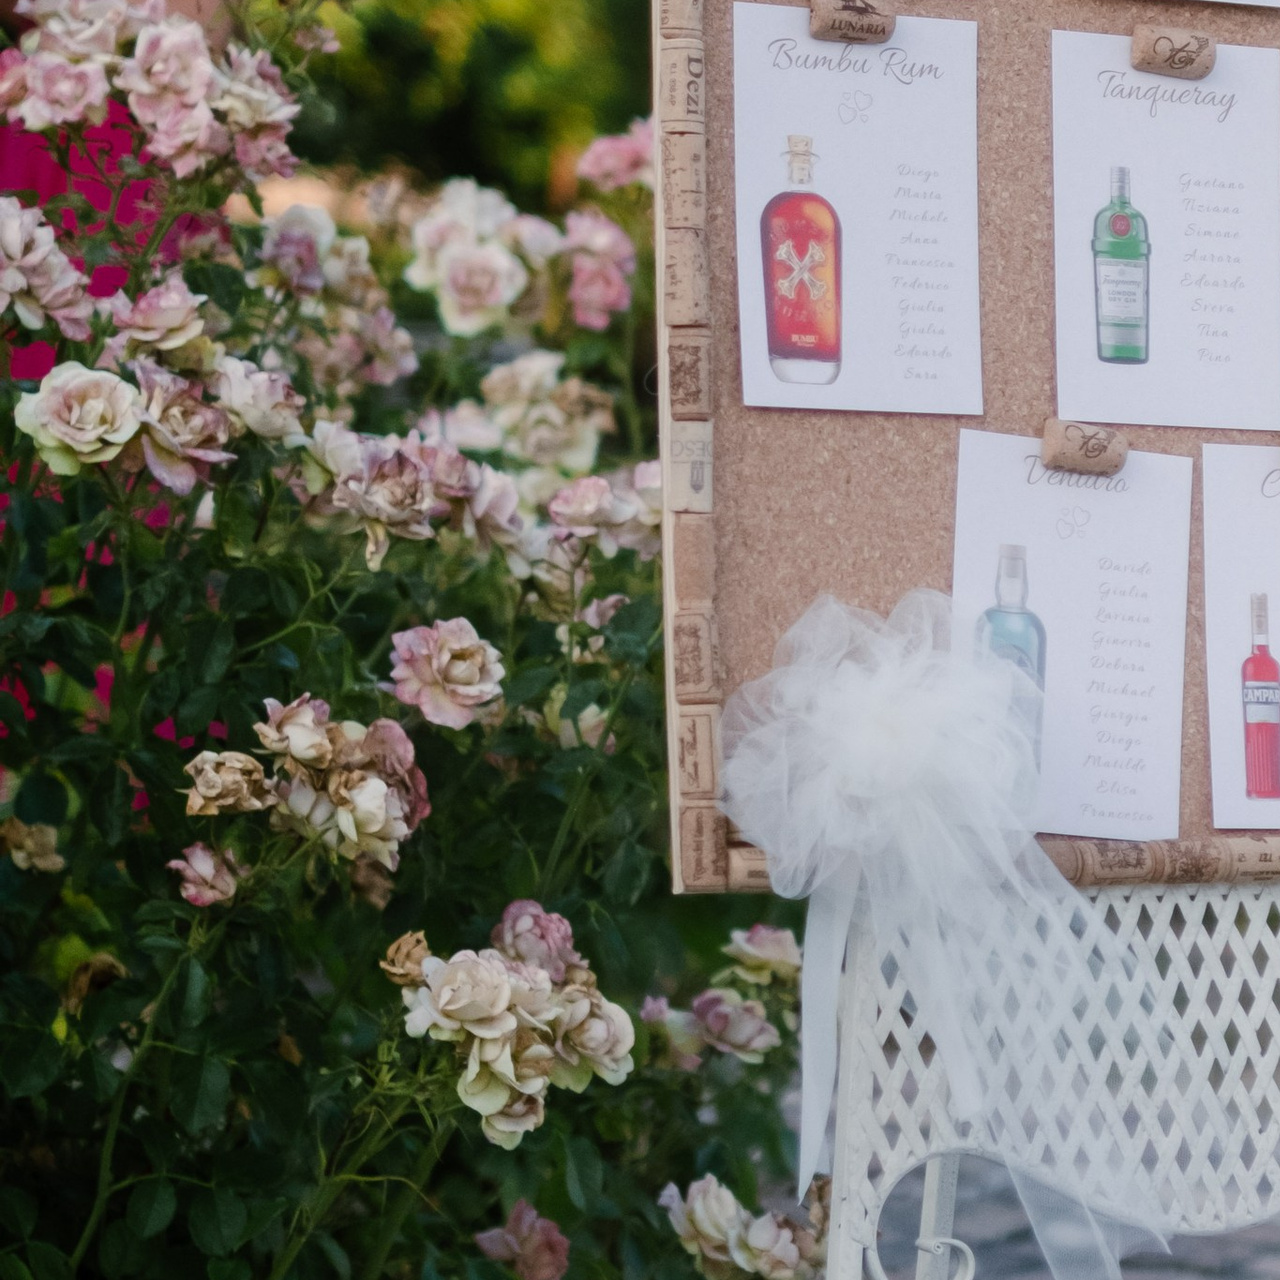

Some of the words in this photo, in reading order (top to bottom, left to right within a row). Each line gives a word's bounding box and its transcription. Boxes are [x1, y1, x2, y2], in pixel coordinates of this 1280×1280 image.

[830, 19, 886, 35] LUNARIA
[767, 38, 872, 74] Bumbu
[878, 47, 945, 85] Rum
[686, 53, 704, 116] Dezi
[1097, 69, 1238, 123] Tanqueray
[897, 163, 940, 183] Diego
[1178, 173, 1246, 193] Gaetano
[1182, 198, 1240, 214] Tiziana
[1184, 223, 1240, 239] Simone
[1183, 248, 1241, 264] Aurora
[892, 275, 950, 291] Federico
[1180, 273, 1246, 290] Edoardo
[894, 344, 953, 359] Edoardo
[1197, 348, 1231, 362] Pino
[1096, 730, 1142, 751] Diego
[1096, 779, 1138, 795] Elisa
